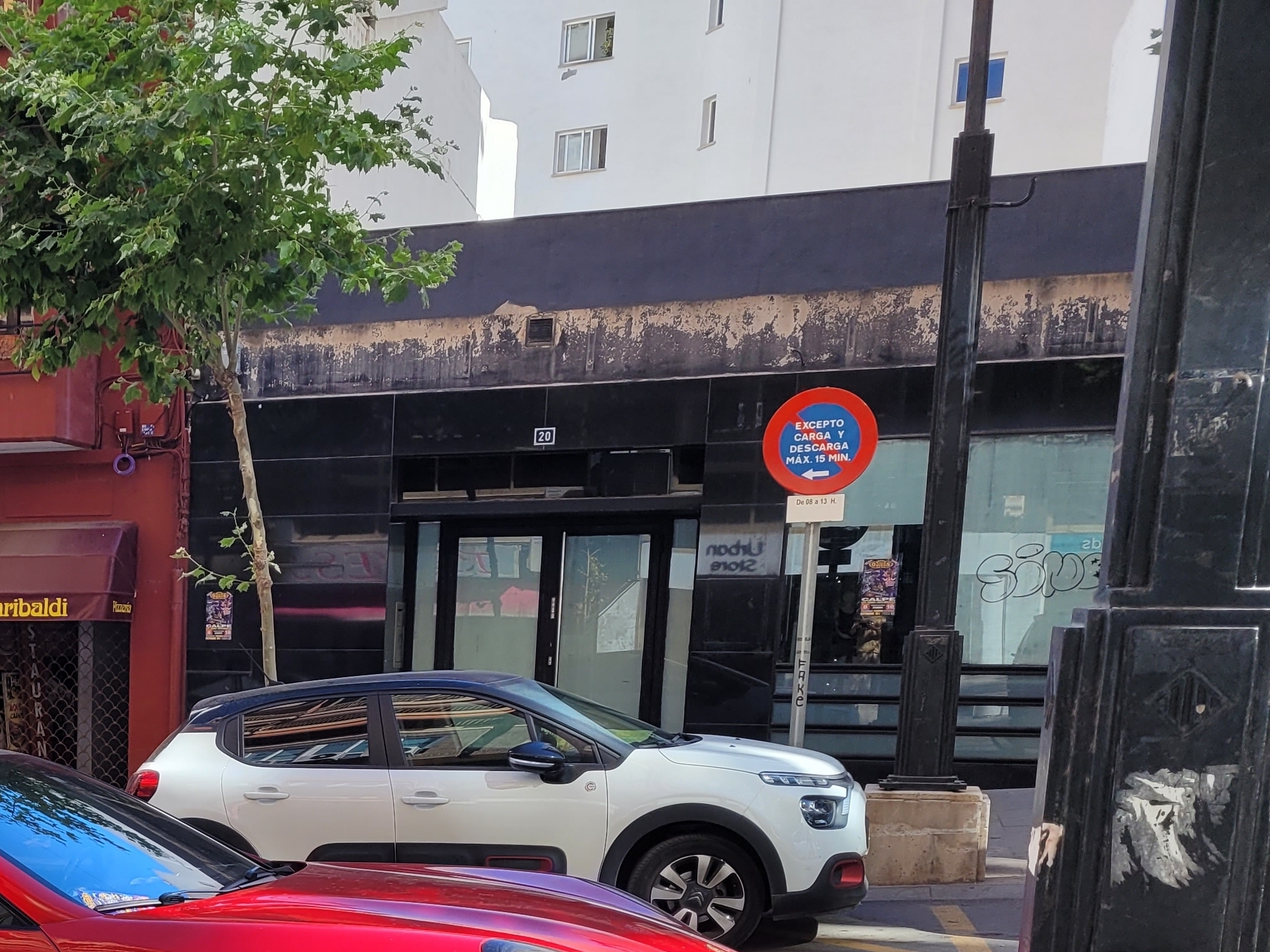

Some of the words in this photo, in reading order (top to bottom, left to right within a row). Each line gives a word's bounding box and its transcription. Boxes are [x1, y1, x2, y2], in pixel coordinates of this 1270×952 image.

[795, 418, 845, 430] EXCEPTO
[538, 431, 551, 441] 20
[794, 431, 832, 441] CARGA
[838, 430, 845, 439] Y
[789, 441, 849, 453] DESCARGA
[785, 454, 813, 465] MÁX.
[815, 454, 826, 463] 15
[828, 452, 852, 463] MIN.
[820, 497, 828, 505] 13
